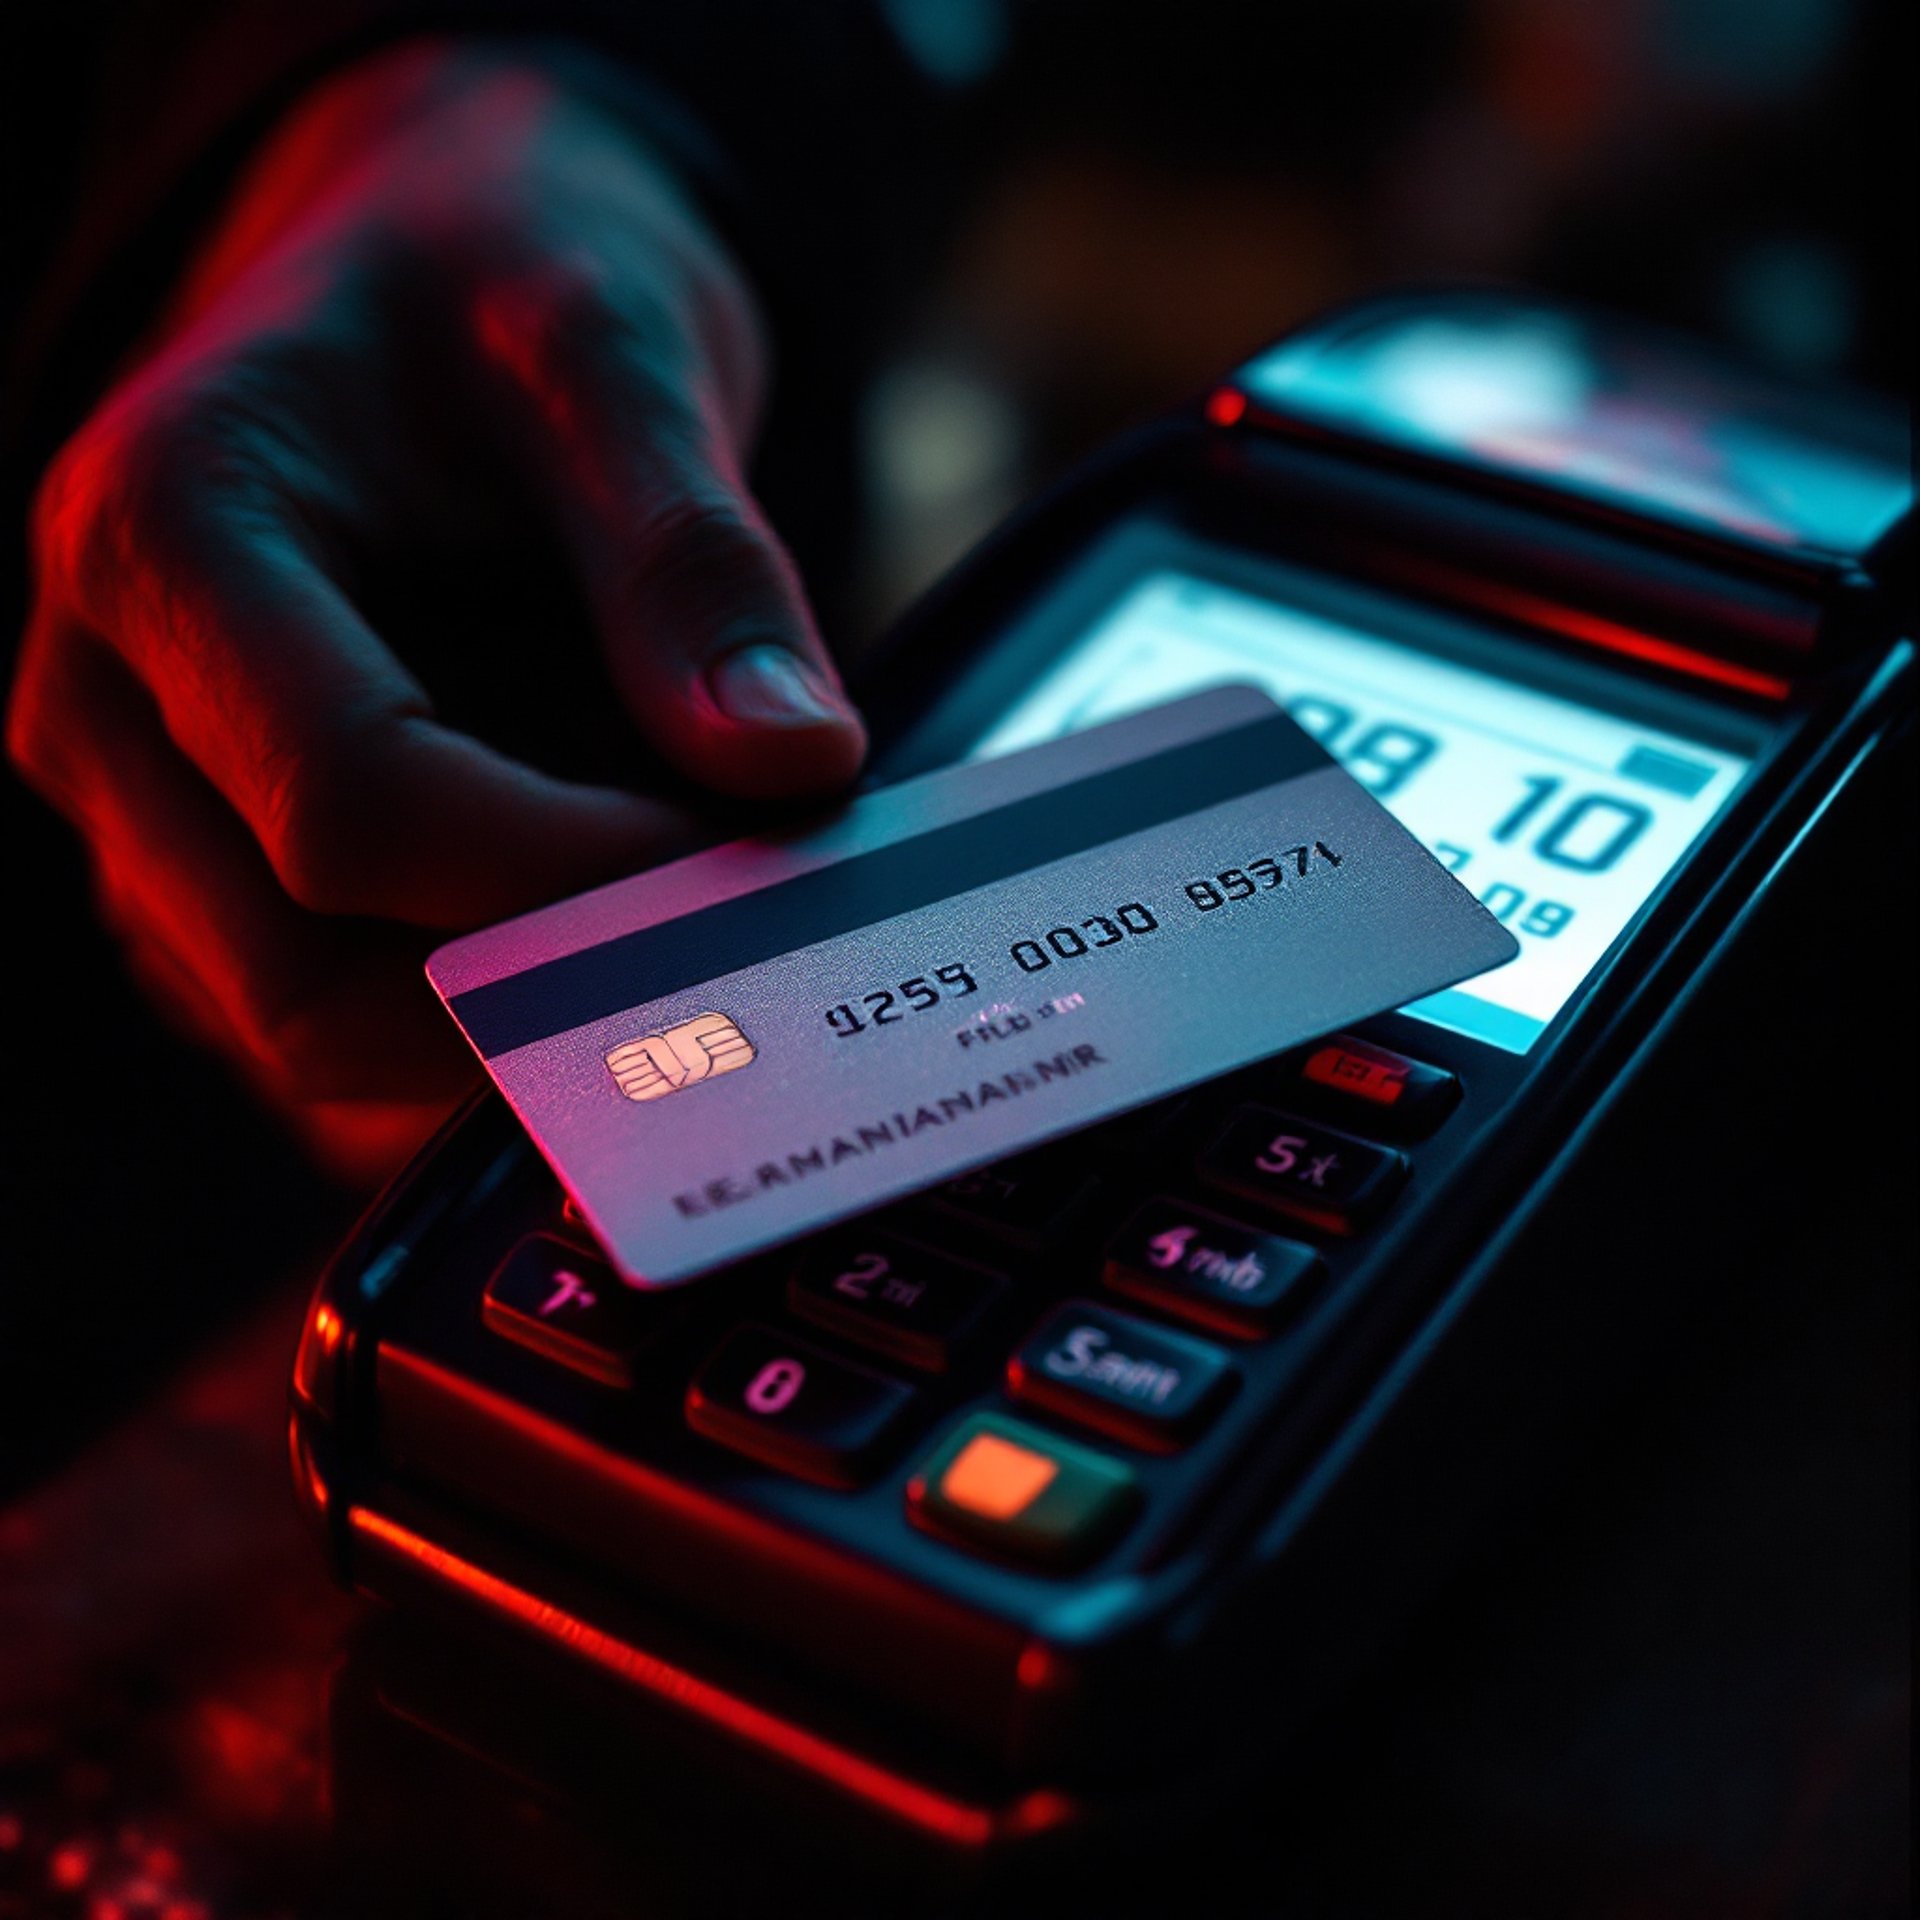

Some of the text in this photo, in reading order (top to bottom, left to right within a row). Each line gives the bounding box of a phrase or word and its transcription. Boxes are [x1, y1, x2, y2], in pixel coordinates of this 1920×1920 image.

[1490, 774, 1653, 874] 10
[834, 1253, 890, 1299] 2
[745, 1358, 806, 1415] 0
